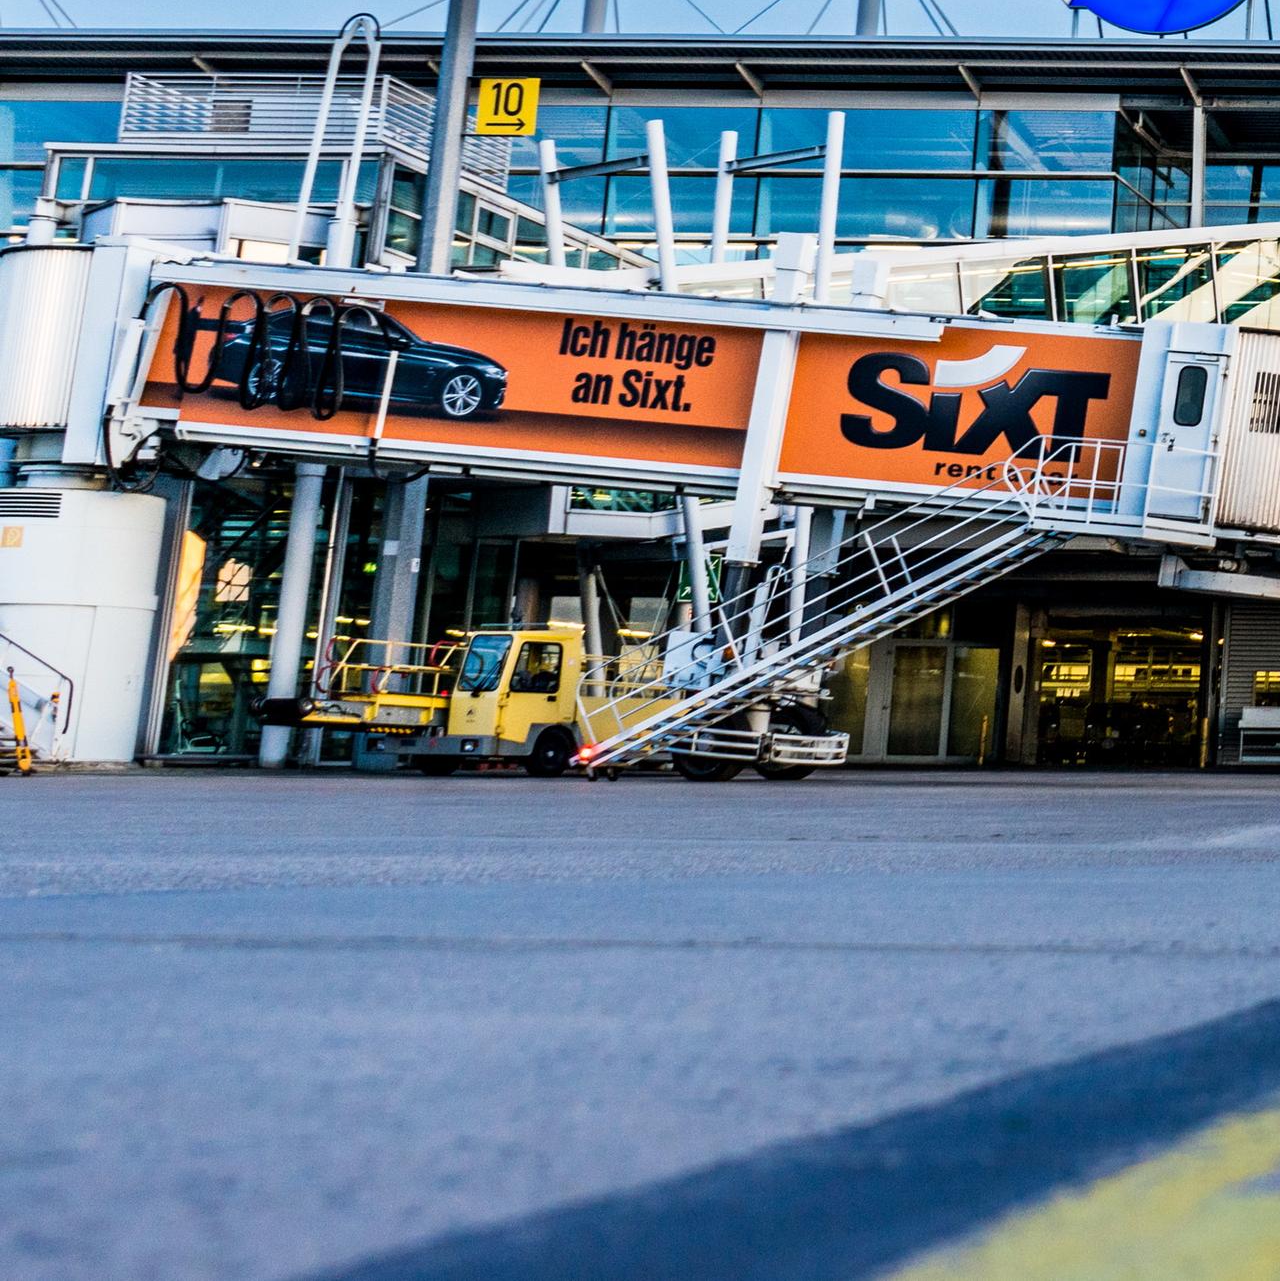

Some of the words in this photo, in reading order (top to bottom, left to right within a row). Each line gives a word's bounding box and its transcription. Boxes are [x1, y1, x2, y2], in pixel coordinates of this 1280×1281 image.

[492, 82, 524, 116] 10
[559, 318, 611, 358] Ich
[615, 322, 716, 370] hänge
[572, 372, 613, 405] an
[618, 369, 692, 412] Sixt.
[934, 461, 996, 481] rent
